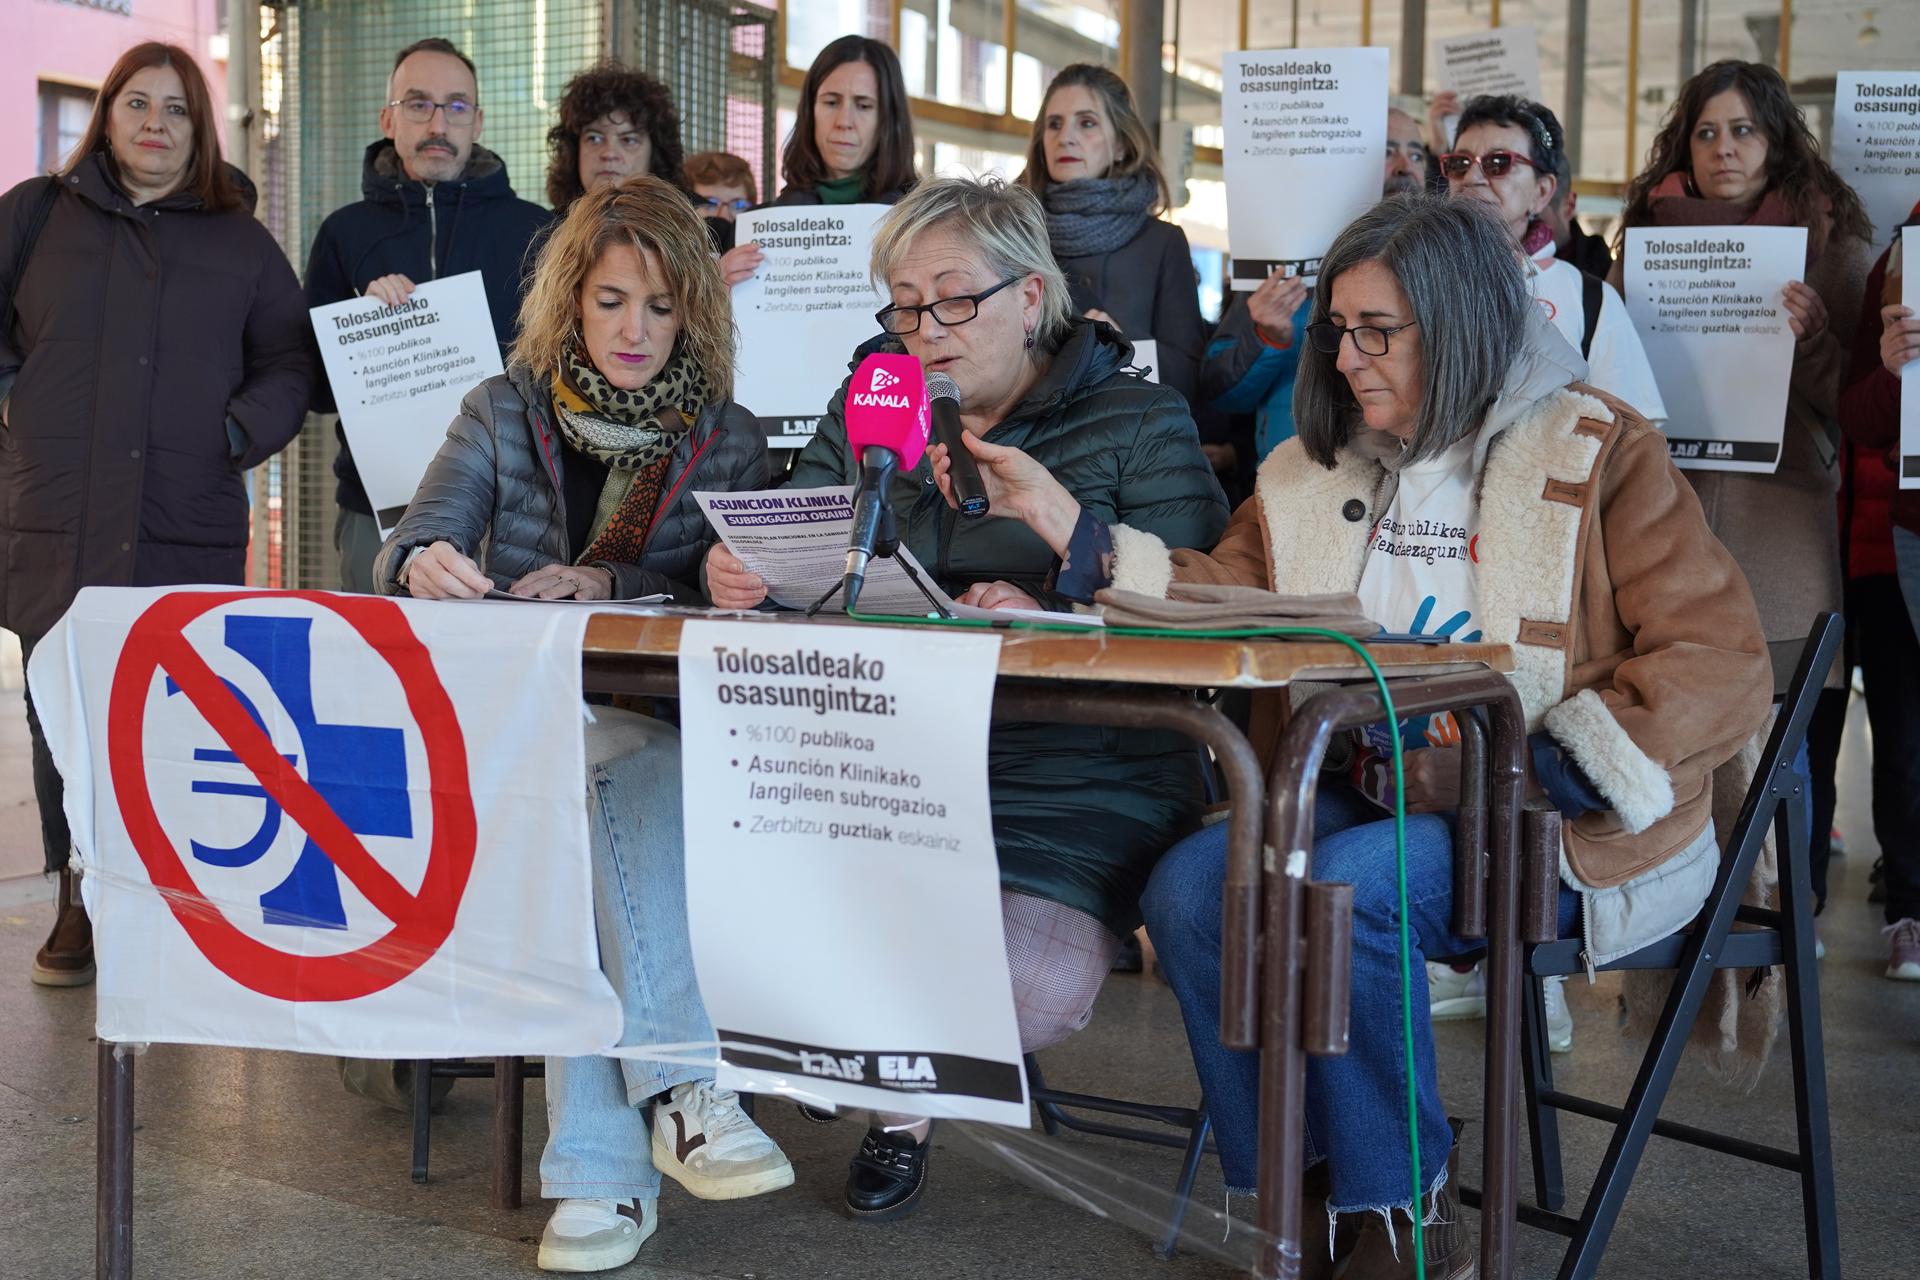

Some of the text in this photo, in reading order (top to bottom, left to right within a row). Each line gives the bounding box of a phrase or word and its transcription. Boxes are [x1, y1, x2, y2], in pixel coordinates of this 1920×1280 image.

[1239, 61, 1332, 77] Tolosaldeako
[1240, 77, 1339, 94] osasungintza:
[1280, 101, 1324, 112] publikoa
[1251, 115, 1349, 126] Asunción Klinikako
[1251, 128, 1362, 142] langileen subrogazioa
[1865, 136, 1915, 146] Asunción
[1289, 145, 1327, 157] guztiak
[1864, 149, 1912, 160] langileen
[752, 217, 845, 234] Tolosaldeako
[751, 233, 852, 250] osasungintza:
[1644, 239, 1745, 254] Tolosaldeako
[793, 256, 839, 267] publikoa
[1644, 257, 1752, 273] osasungintza:
[764, 270, 864, 283] Asunción Klinikako
[764, 287, 811, 297] langileen
[1688, 280, 1736, 291] publikoa
[805, 301, 844, 313] guztiak
[1658, 294, 1763, 305] Asunción Klinikako
[332, 298, 429, 330] Tolosaldeako
[1658, 308, 1777, 320] langileen subrogazioa
[338, 312, 440, 346] osasungintza:
[1701, 323, 1741, 334] guztiak
[387, 336, 432, 354] publikoa
[362, 345, 460, 376] Asunción Klinikako
[365, 355, 476, 389] langileen subrogazioa
[409, 379, 447, 397] guztiak
[853, 393, 910, 409] KANALA
[709, 494, 851, 511] ASUNCION KLINIKA
[728, 509, 852, 526] SUBROGAZIOA ORAIN!
[1409, 520, 1467, 539] ublikoa
[713, 646, 884, 681] Tolosaldeako
[718, 683, 896, 716] osasungintza:
[746, 724, 875, 751] %100 publikoa
[748, 755, 921, 789] Asunción Klinikako
[749, 781, 947, 818] langileen subrogazioa
[749, 815, 961, 852] Zerbitzu guztiak eskainiz
[878, 1056, 937, 1081] ELA
